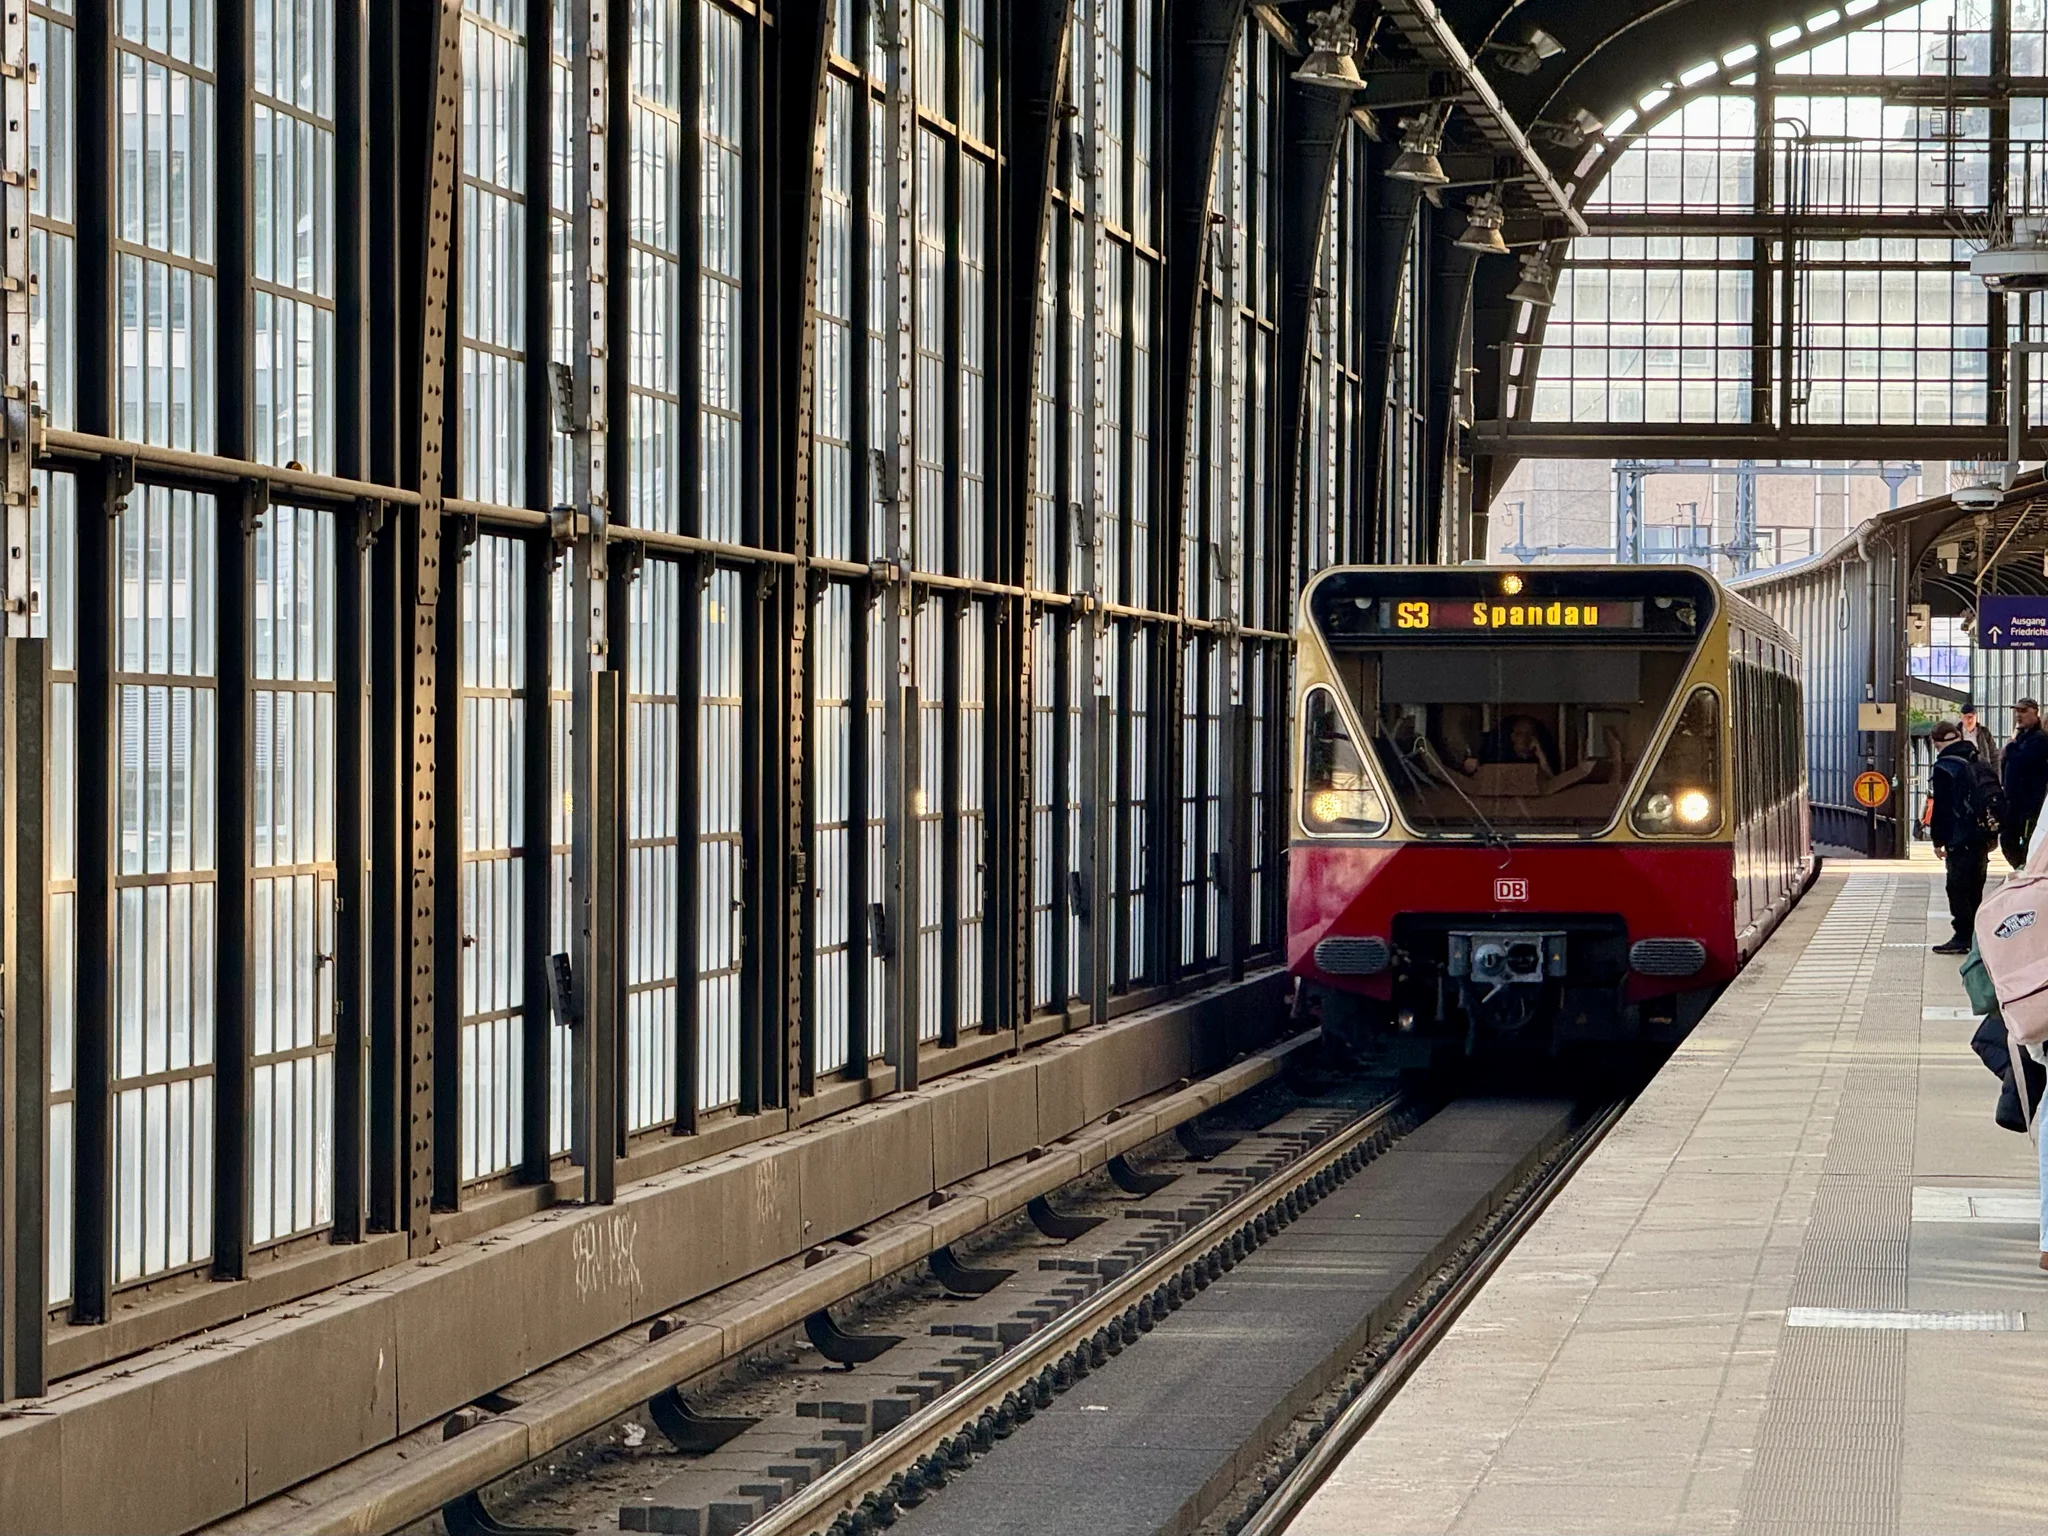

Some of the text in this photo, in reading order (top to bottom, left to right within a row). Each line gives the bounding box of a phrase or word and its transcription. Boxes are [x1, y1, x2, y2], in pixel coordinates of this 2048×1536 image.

[1397, 602, 1599, 628] S3 Spandau
[2011, 616, 2046, 627] Ausgang
[2010, 627, 2048, 637] Friedrichs
[1498, 881, 1525, 898] DB
